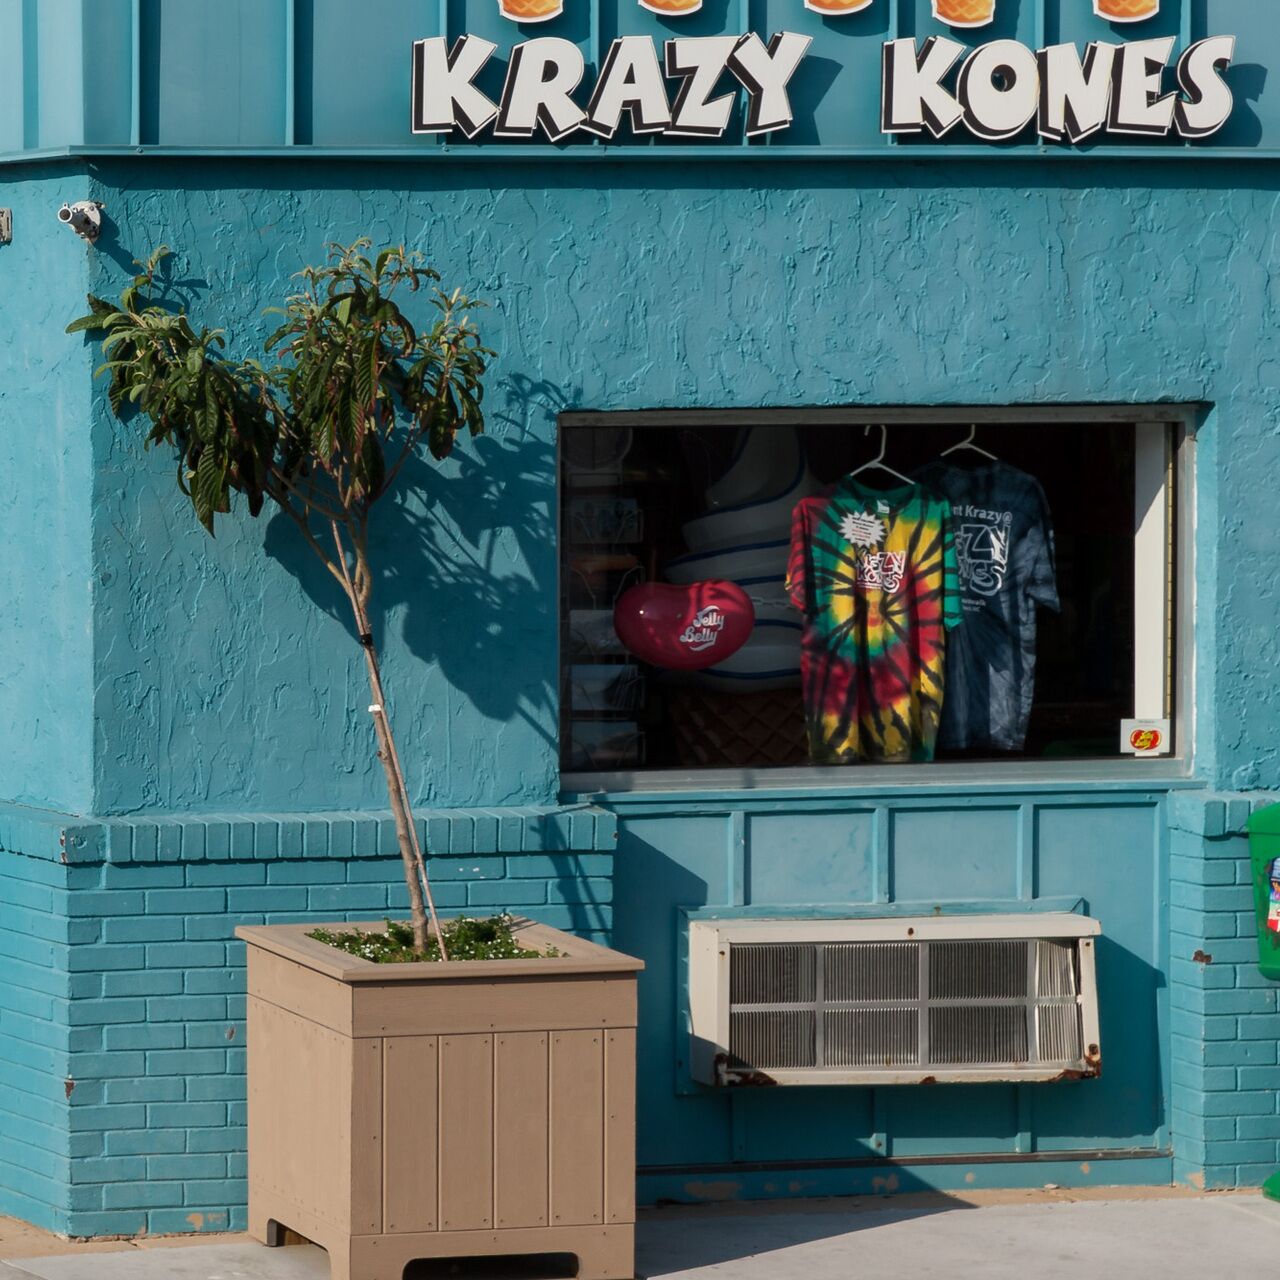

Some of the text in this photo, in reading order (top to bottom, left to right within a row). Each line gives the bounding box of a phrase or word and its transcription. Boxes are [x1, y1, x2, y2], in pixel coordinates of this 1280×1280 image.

[411, 31, 1236, 143] KRAZY KONES
[693, 605, 725, 631] Jelly
[680, 626, 718, 651] Belly
